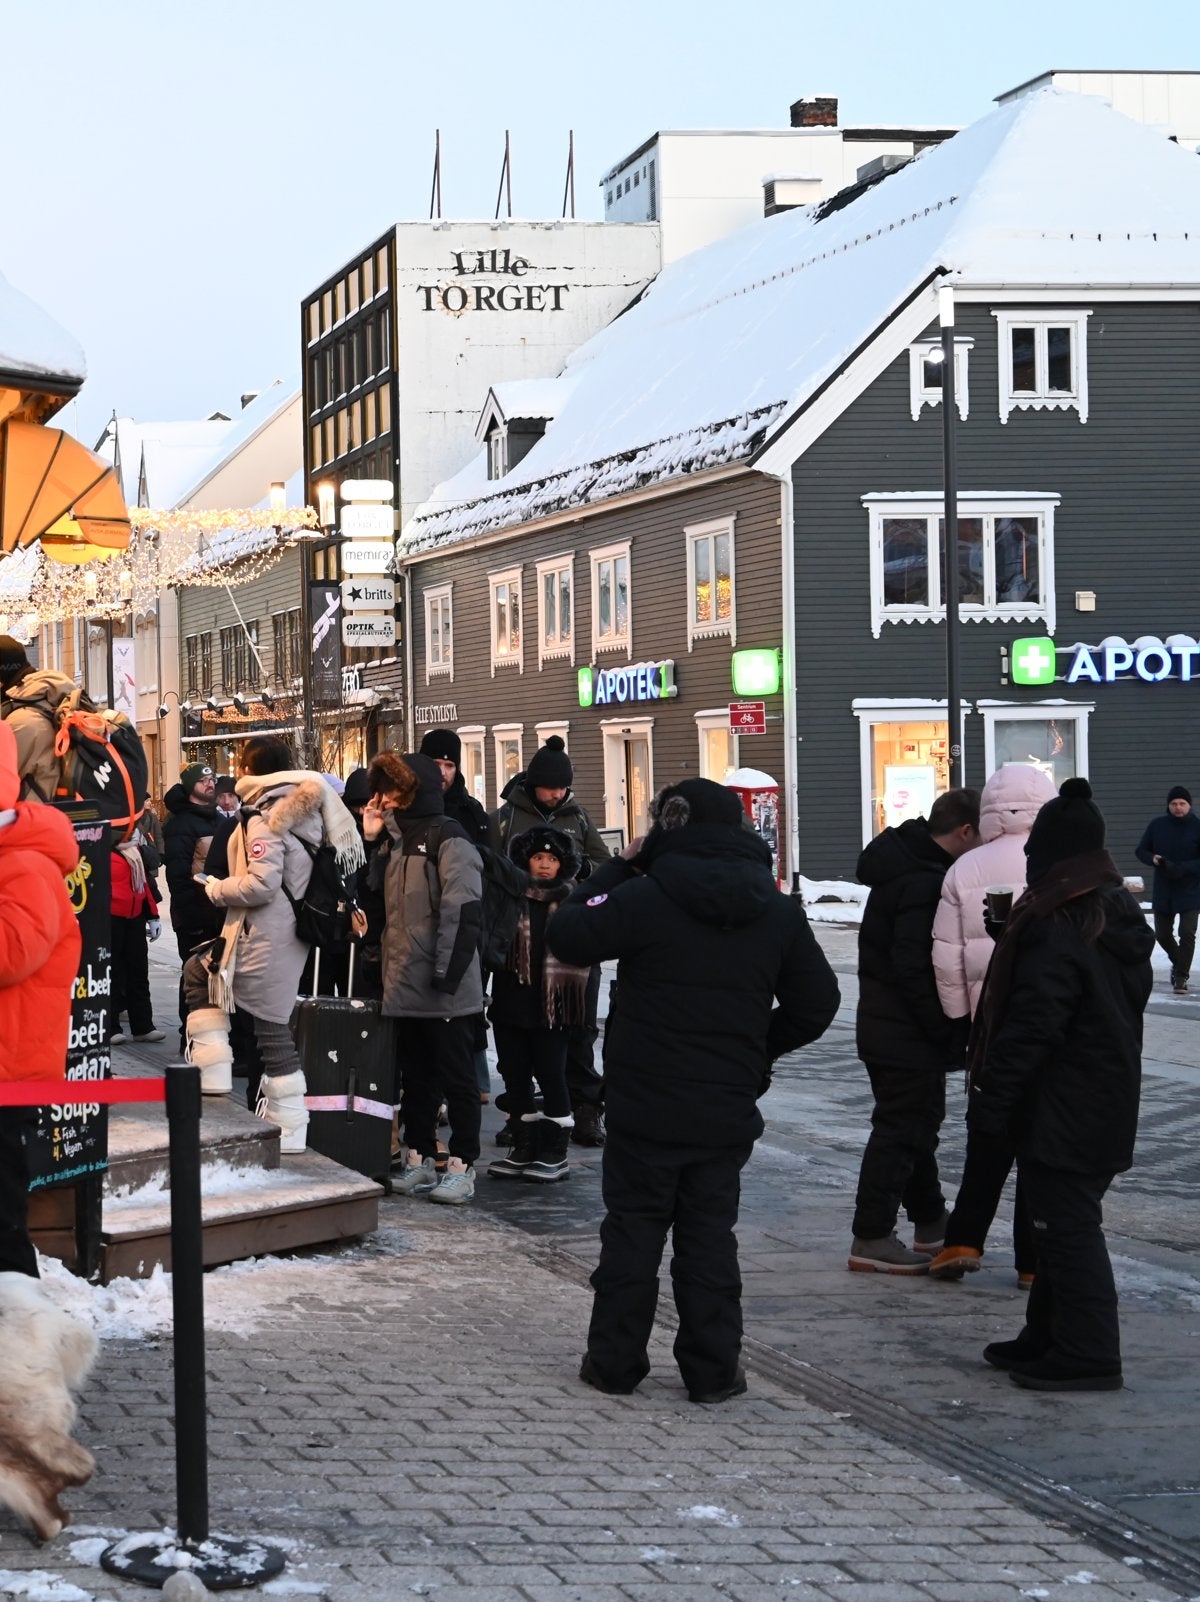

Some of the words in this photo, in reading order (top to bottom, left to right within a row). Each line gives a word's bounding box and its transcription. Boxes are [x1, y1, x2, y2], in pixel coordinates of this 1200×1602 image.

[450, 248, 530, 277] Lille
[416, 284, 569, 312] TORGET
[345, 551, 389, 561] memira
[364, 587, 393, 600] britts
[1066, 646, 1200, 682] APOT
[595, 667, 659, 704] APOTEK
[68, 1008, 107, 1049] beef
[50, 1102, 100, 1125] Soups
[62, 1126, 77, 1140] Fish
[63, 1141, 83, 1158] Vegan
